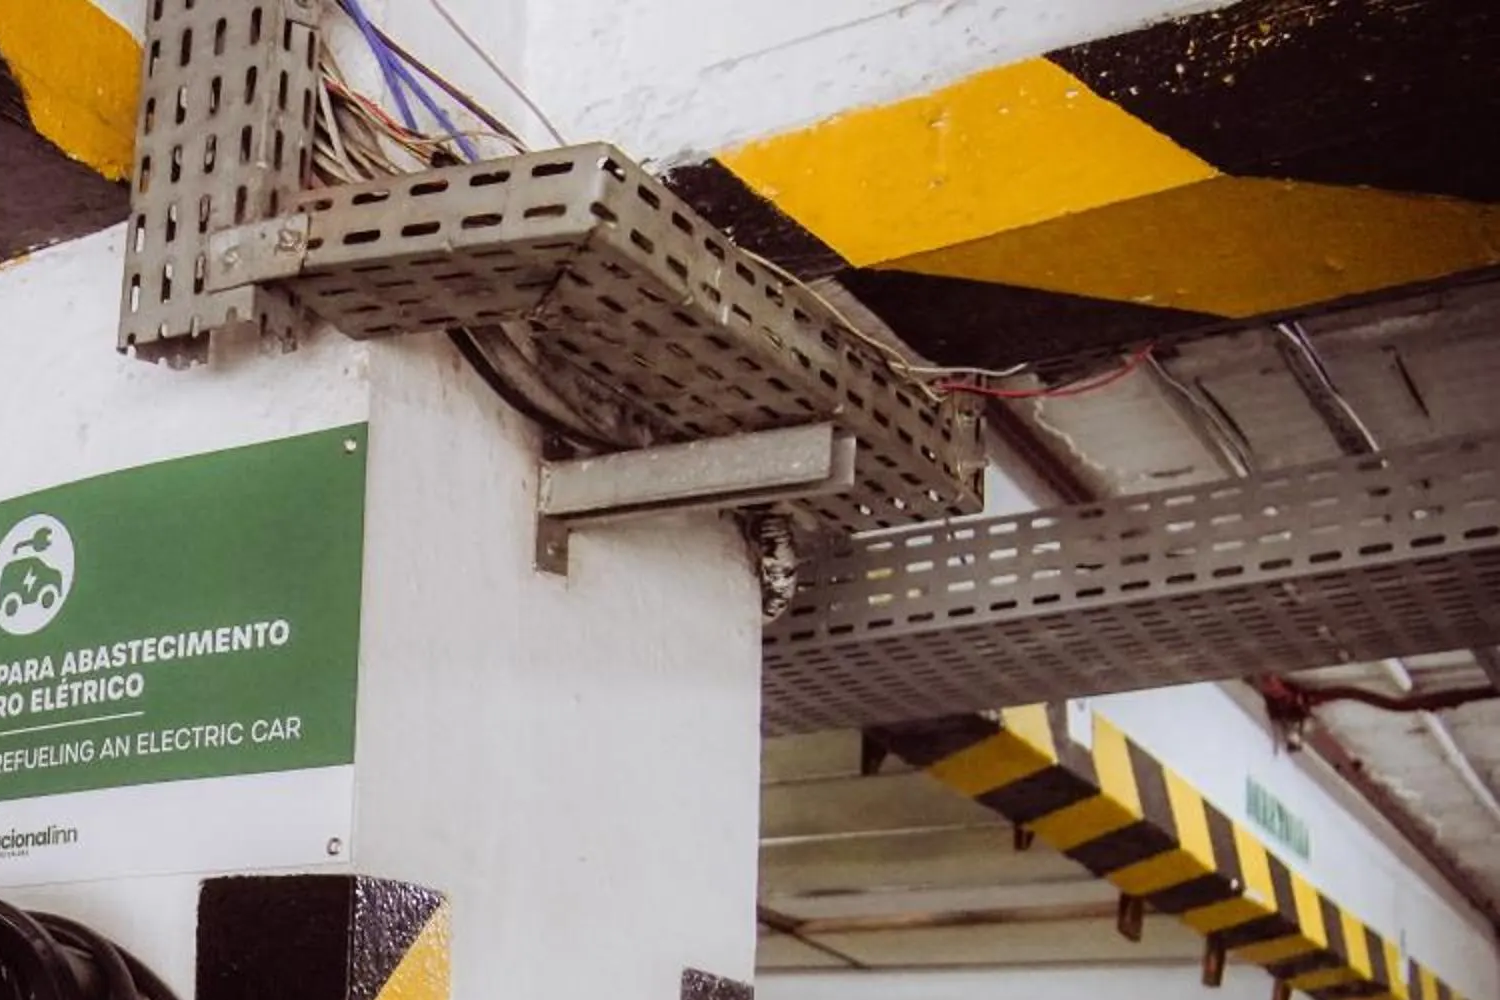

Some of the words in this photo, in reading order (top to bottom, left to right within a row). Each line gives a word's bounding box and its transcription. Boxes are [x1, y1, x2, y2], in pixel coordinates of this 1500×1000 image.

[61, 619, 291, 677] ABASTECIMENTO
[30, 673, 145, 713] ELÉTRICO
[99, 735, 131, 760] AN
[136, 722, 244, 755] ELECTRIC
[251, 716, 302, 743] CAR
